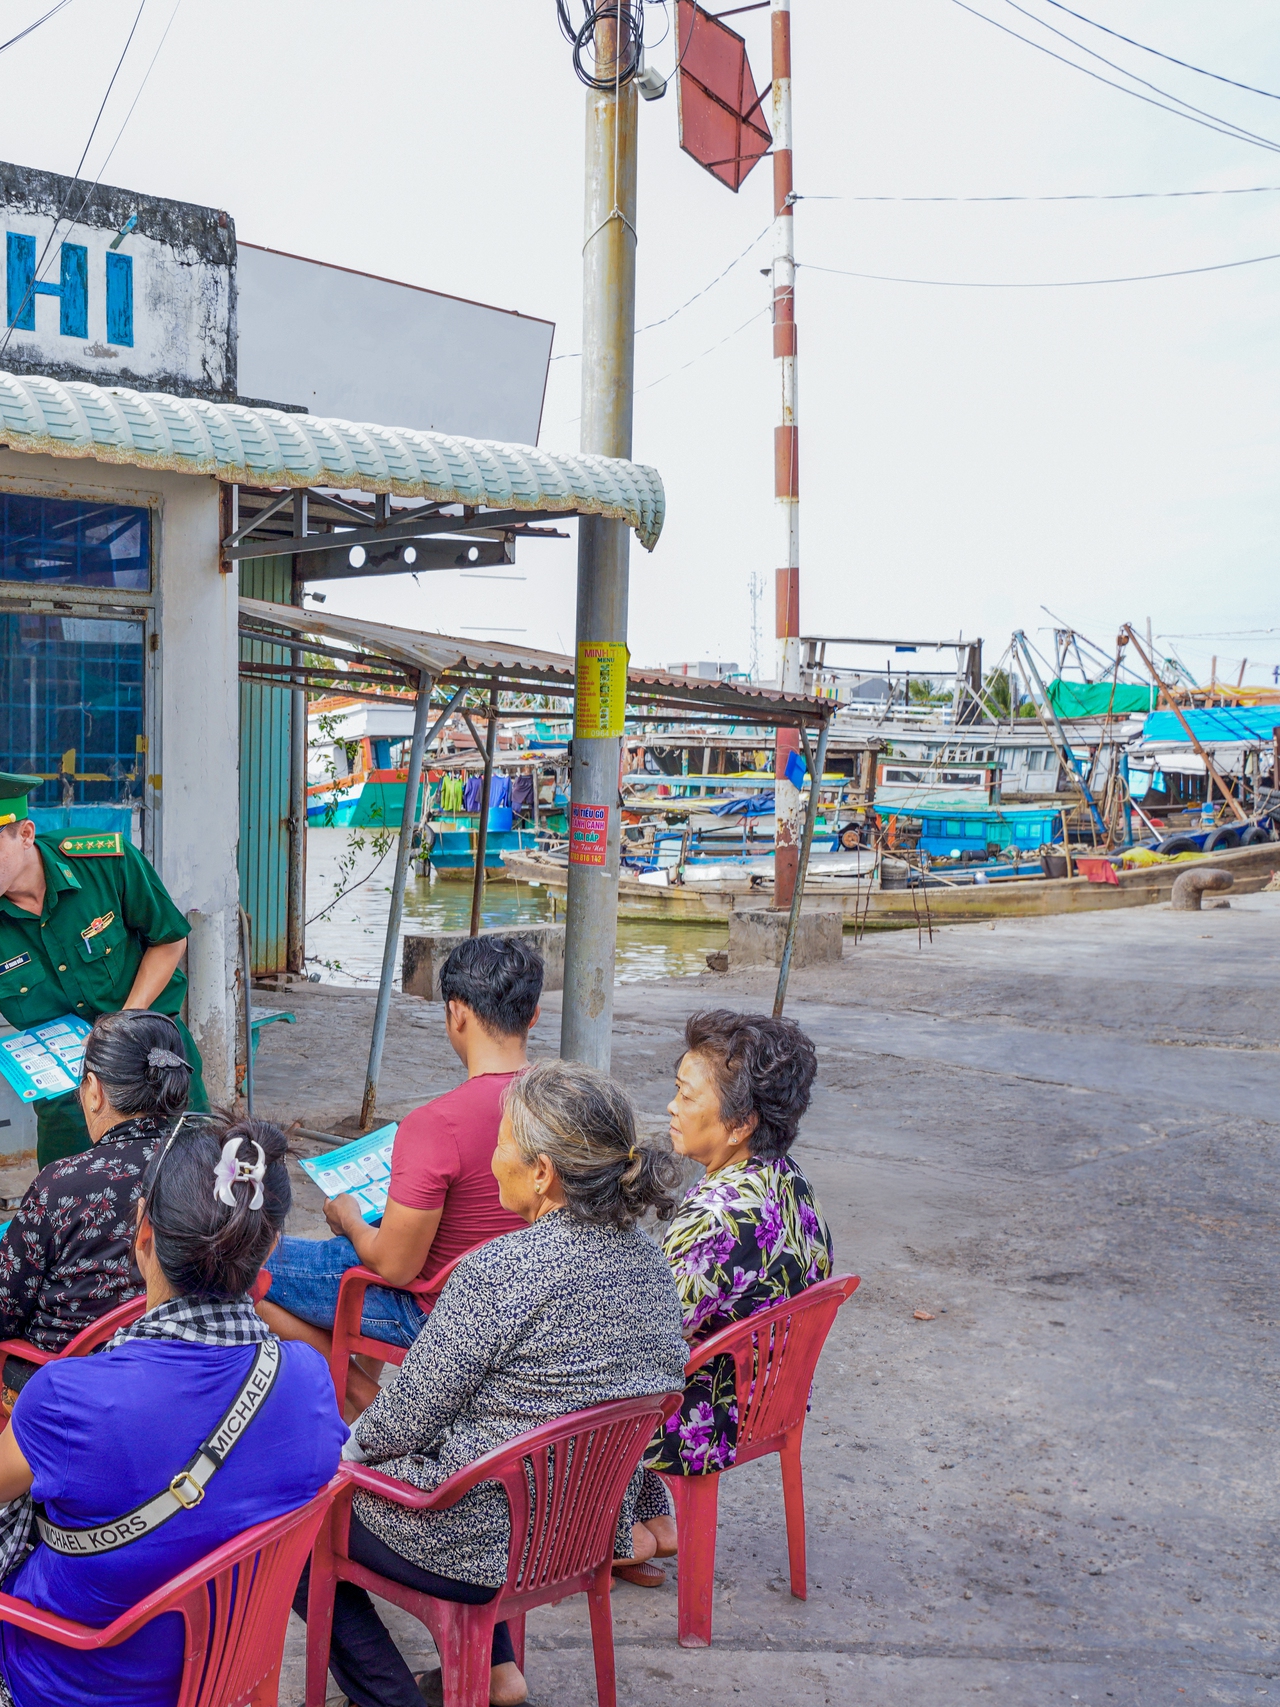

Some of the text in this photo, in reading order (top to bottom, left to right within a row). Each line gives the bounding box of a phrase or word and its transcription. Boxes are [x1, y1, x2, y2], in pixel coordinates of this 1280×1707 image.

[584, 649, 608, 657] MINH
[587, 820, 605, 830] CANH
[211, 1368, 272, 1460] MICHAEL
[44, 1516, 147, 1550] MICHAEL KORS
